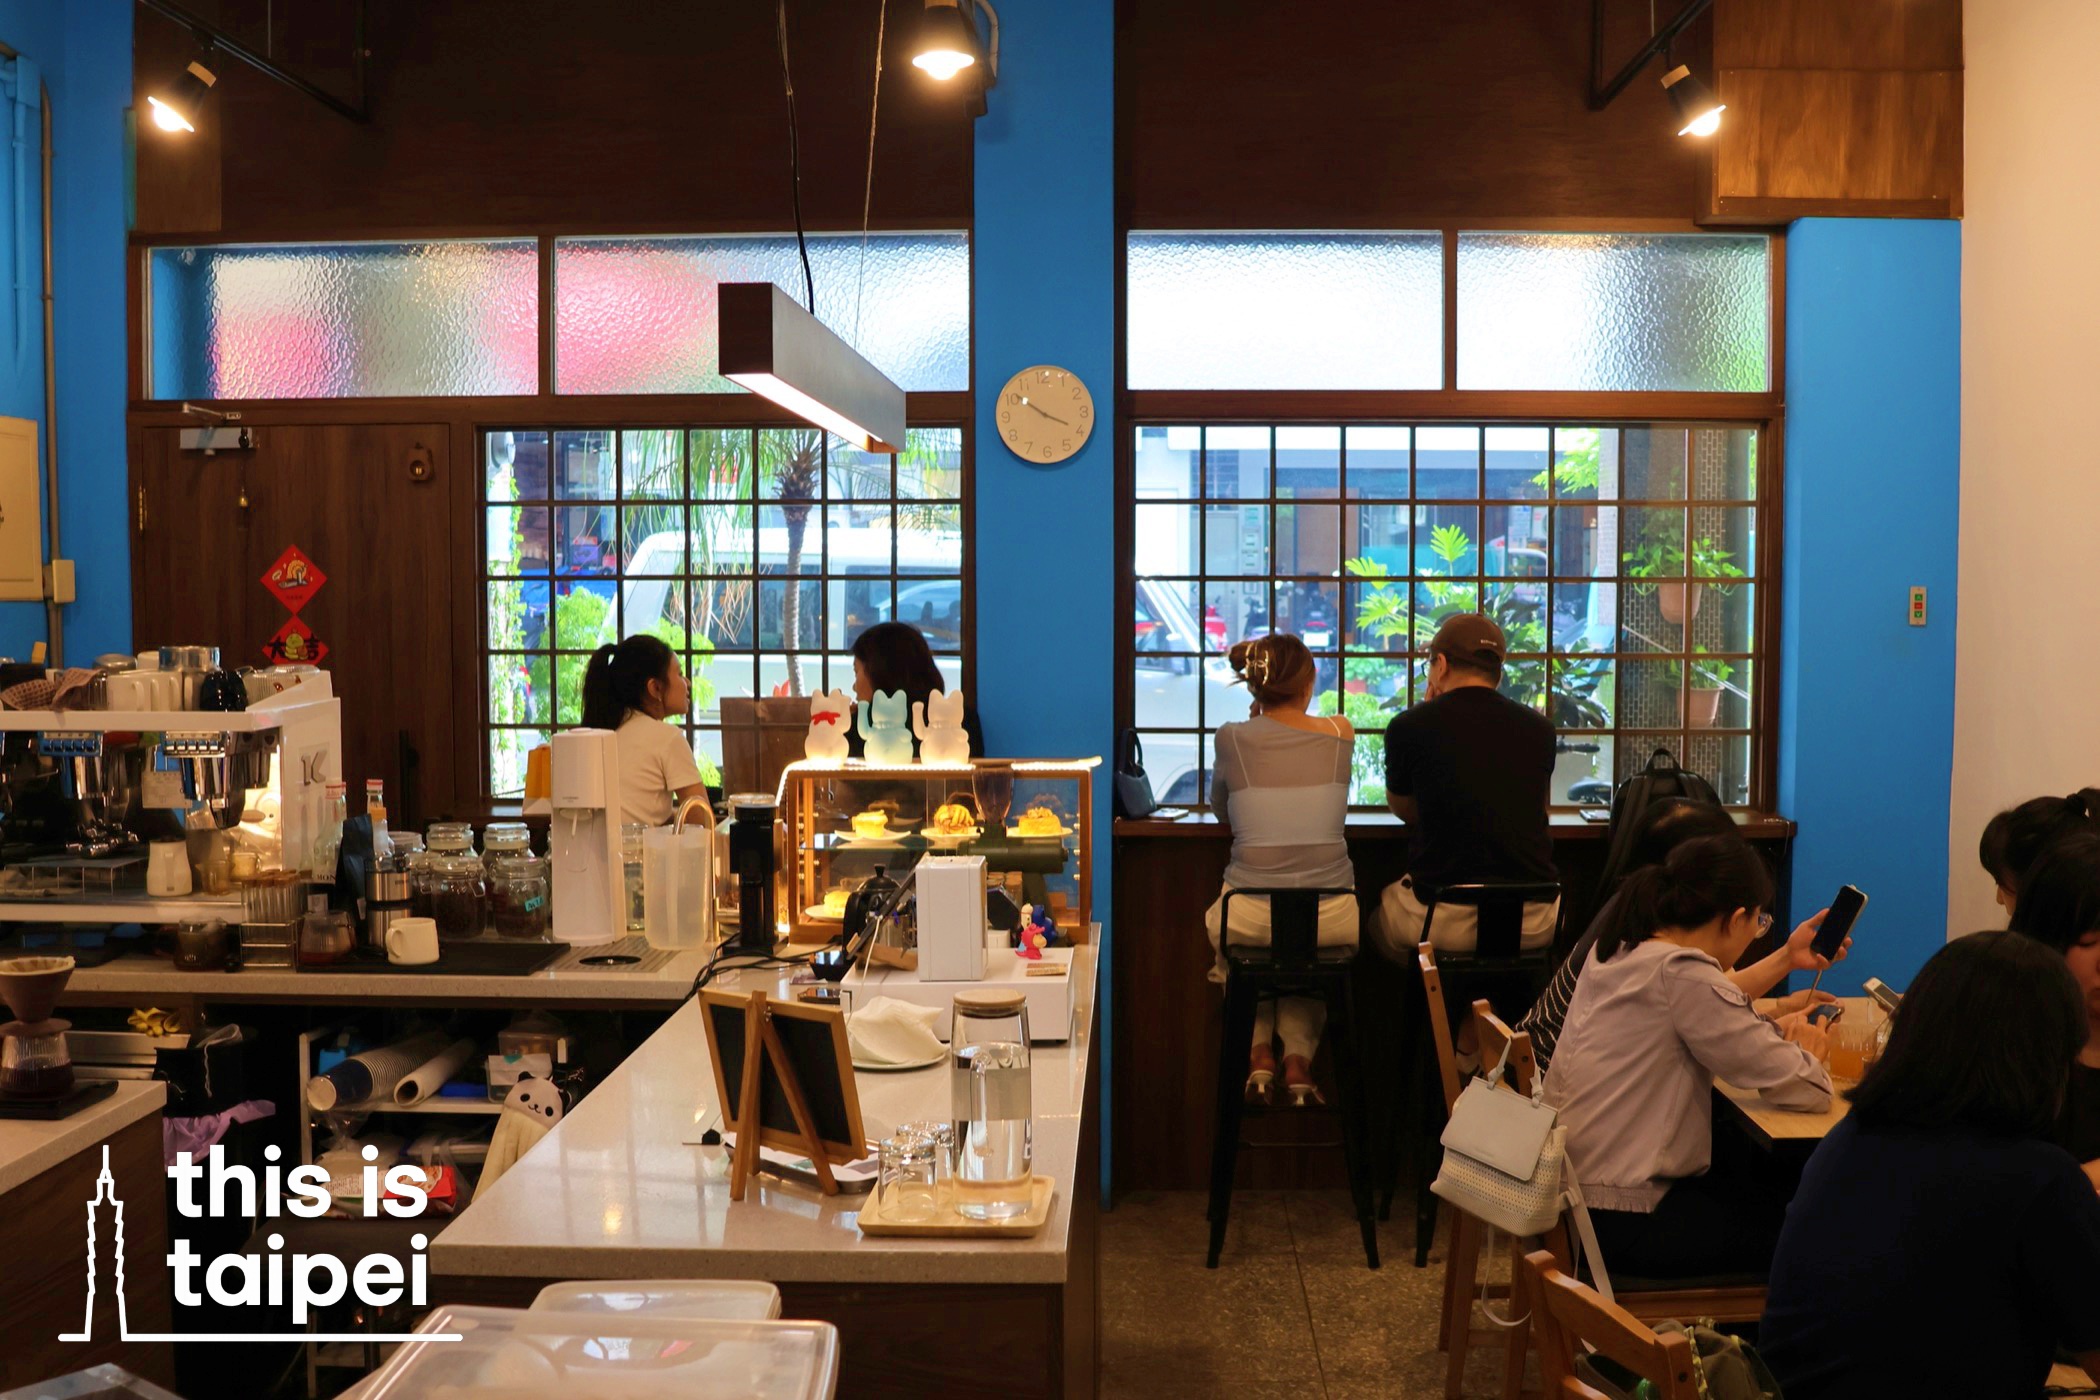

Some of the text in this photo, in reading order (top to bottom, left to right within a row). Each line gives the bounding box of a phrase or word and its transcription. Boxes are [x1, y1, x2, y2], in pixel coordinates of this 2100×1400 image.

[1036, 371, 1050, 384] 12
[1019, 378, 1029, 391] 11
[1006, 393, 1019, 406] 10
[1072, 387, 1082, 400] 2
[1001, 411, 1010, 423] 9
[1080, 405, 1088, 418] 3
[1009, 429, 1018, 441] 8
[1076, 425, 1084, 437] 4
[1025, 441, 1033, 454] 7
[1062, 439, 1071, 451] 5
[1043, 446, 1052, 458] 6
[316, 872, 337, 882] MON
